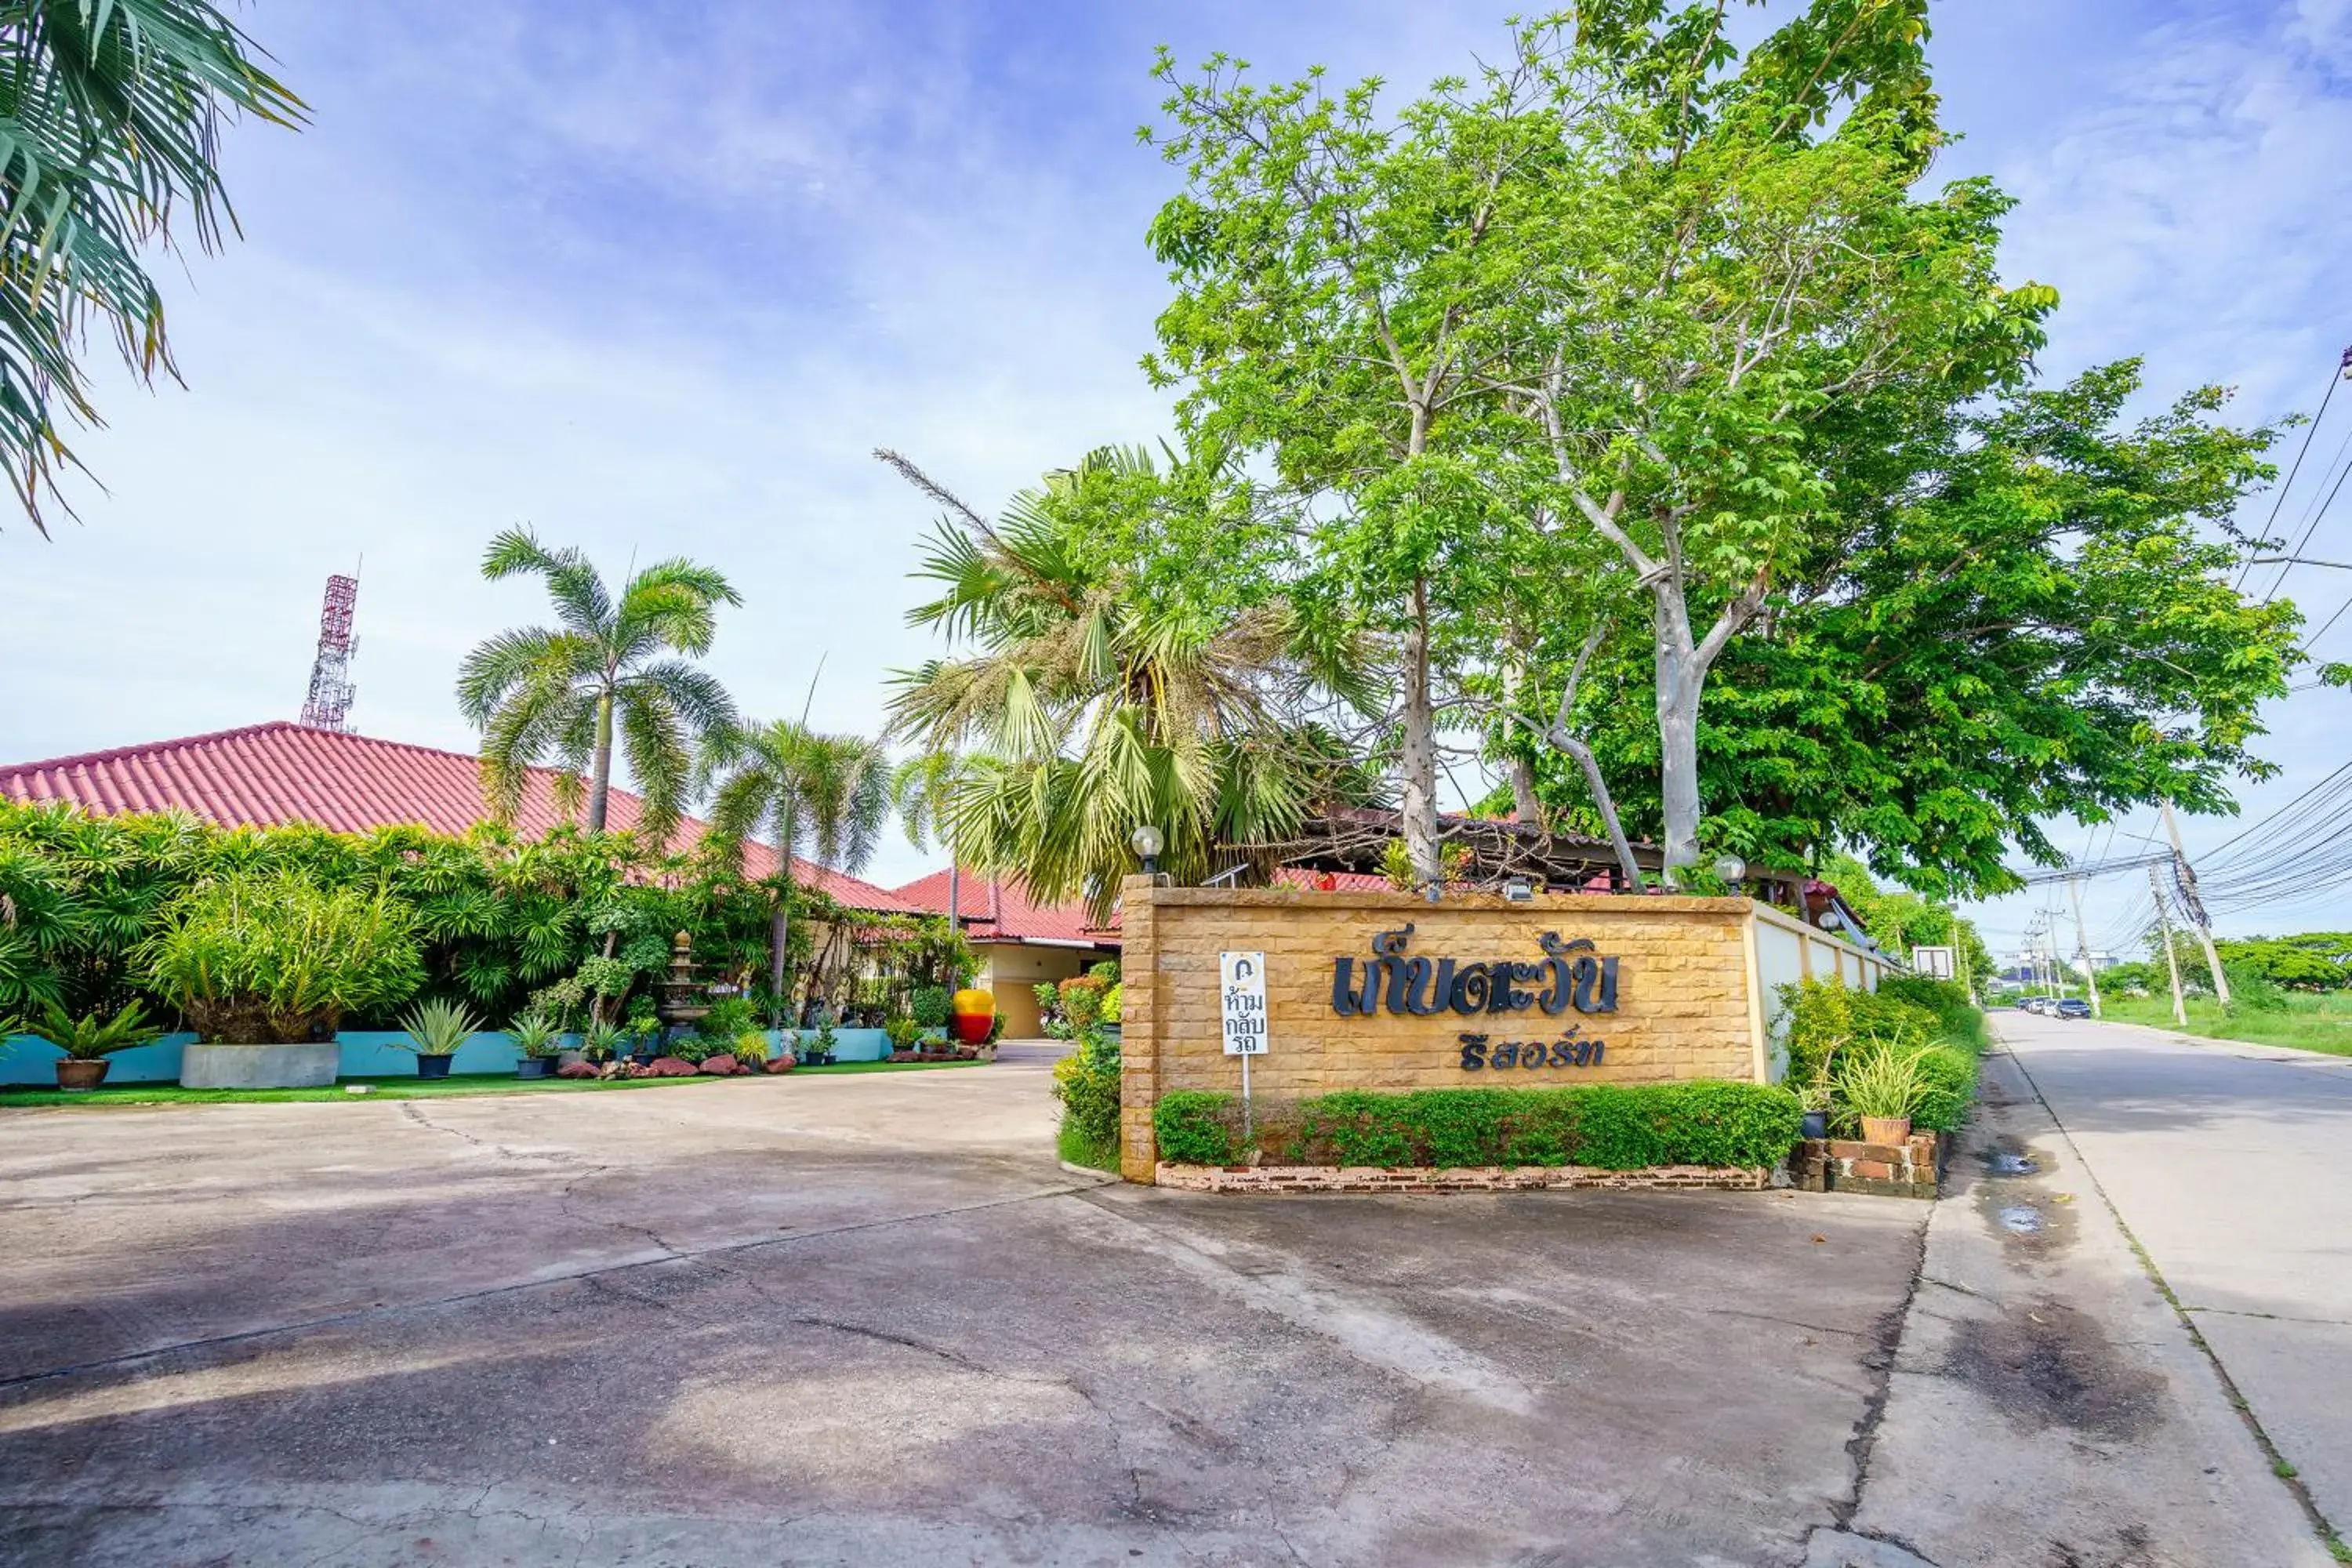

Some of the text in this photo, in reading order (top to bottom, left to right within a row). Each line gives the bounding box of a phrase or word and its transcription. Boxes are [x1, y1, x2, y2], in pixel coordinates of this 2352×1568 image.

[1333, 923, 1619, 1016] เก็บตะวัน
[1224, 985, 1263, 1011] ห้าม
[1225, 1011, 1265, 1035] กลับ
[1232, 1036, 1257, 1052] รถ
[1458, 1023, 1606, 1071] รีสอร์ท
